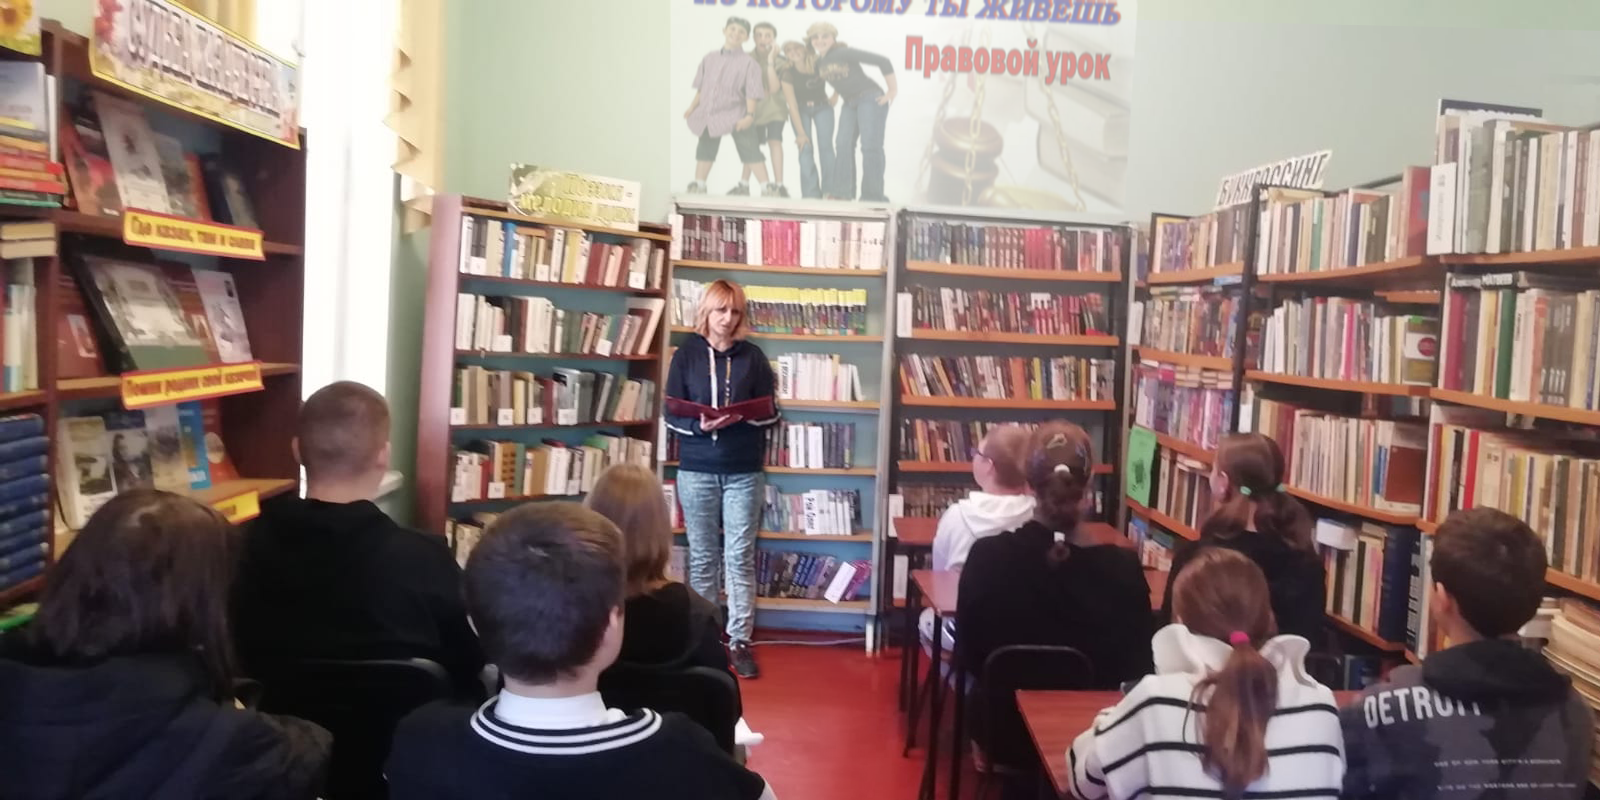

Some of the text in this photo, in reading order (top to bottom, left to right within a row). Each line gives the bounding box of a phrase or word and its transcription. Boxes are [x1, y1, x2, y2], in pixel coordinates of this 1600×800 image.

[975, 0, 1121, 26] ЖИВЕШЬ
[905, 35, 1112, 86] Правовой урок
